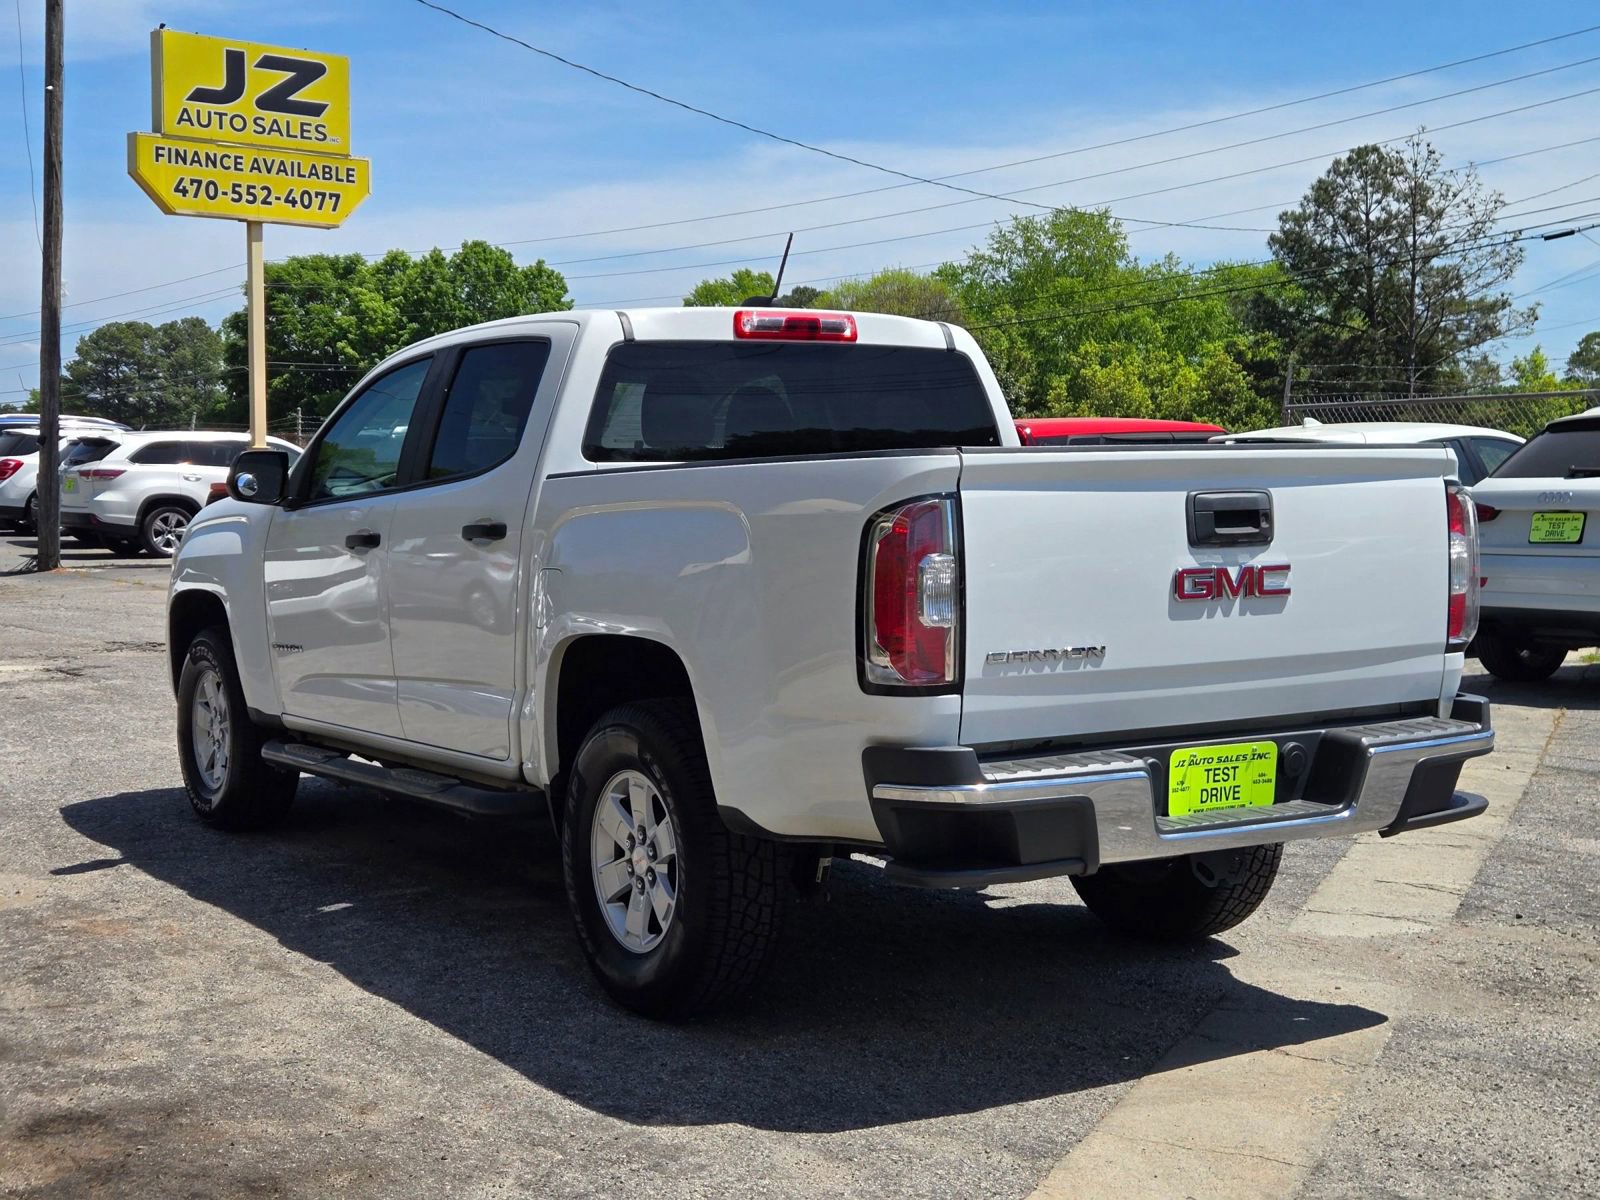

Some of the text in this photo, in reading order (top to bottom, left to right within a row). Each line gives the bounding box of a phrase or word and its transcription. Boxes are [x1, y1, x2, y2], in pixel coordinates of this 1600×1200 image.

[184, 48, 329, 118] JZ
[176, 108, 247, 132] AUTO
[253, 116, 328, 141] SALES
[154, 146, 356, 184] FINANCE AVAILABLE
[174, 177, 341, 212] 470-552-4077
[1174, 564, 1291, 601] GMC
[986, 645, 1106, 664] CANYON
[1175, 759, 1186, 768] JZ
[1188, 756, 1214, 766] AUTO
[1216, 753, 1248, 764] SALES
[1205, 766, 1239, 784] TEST
[1200, 785, 1241, 804] DRIVE
